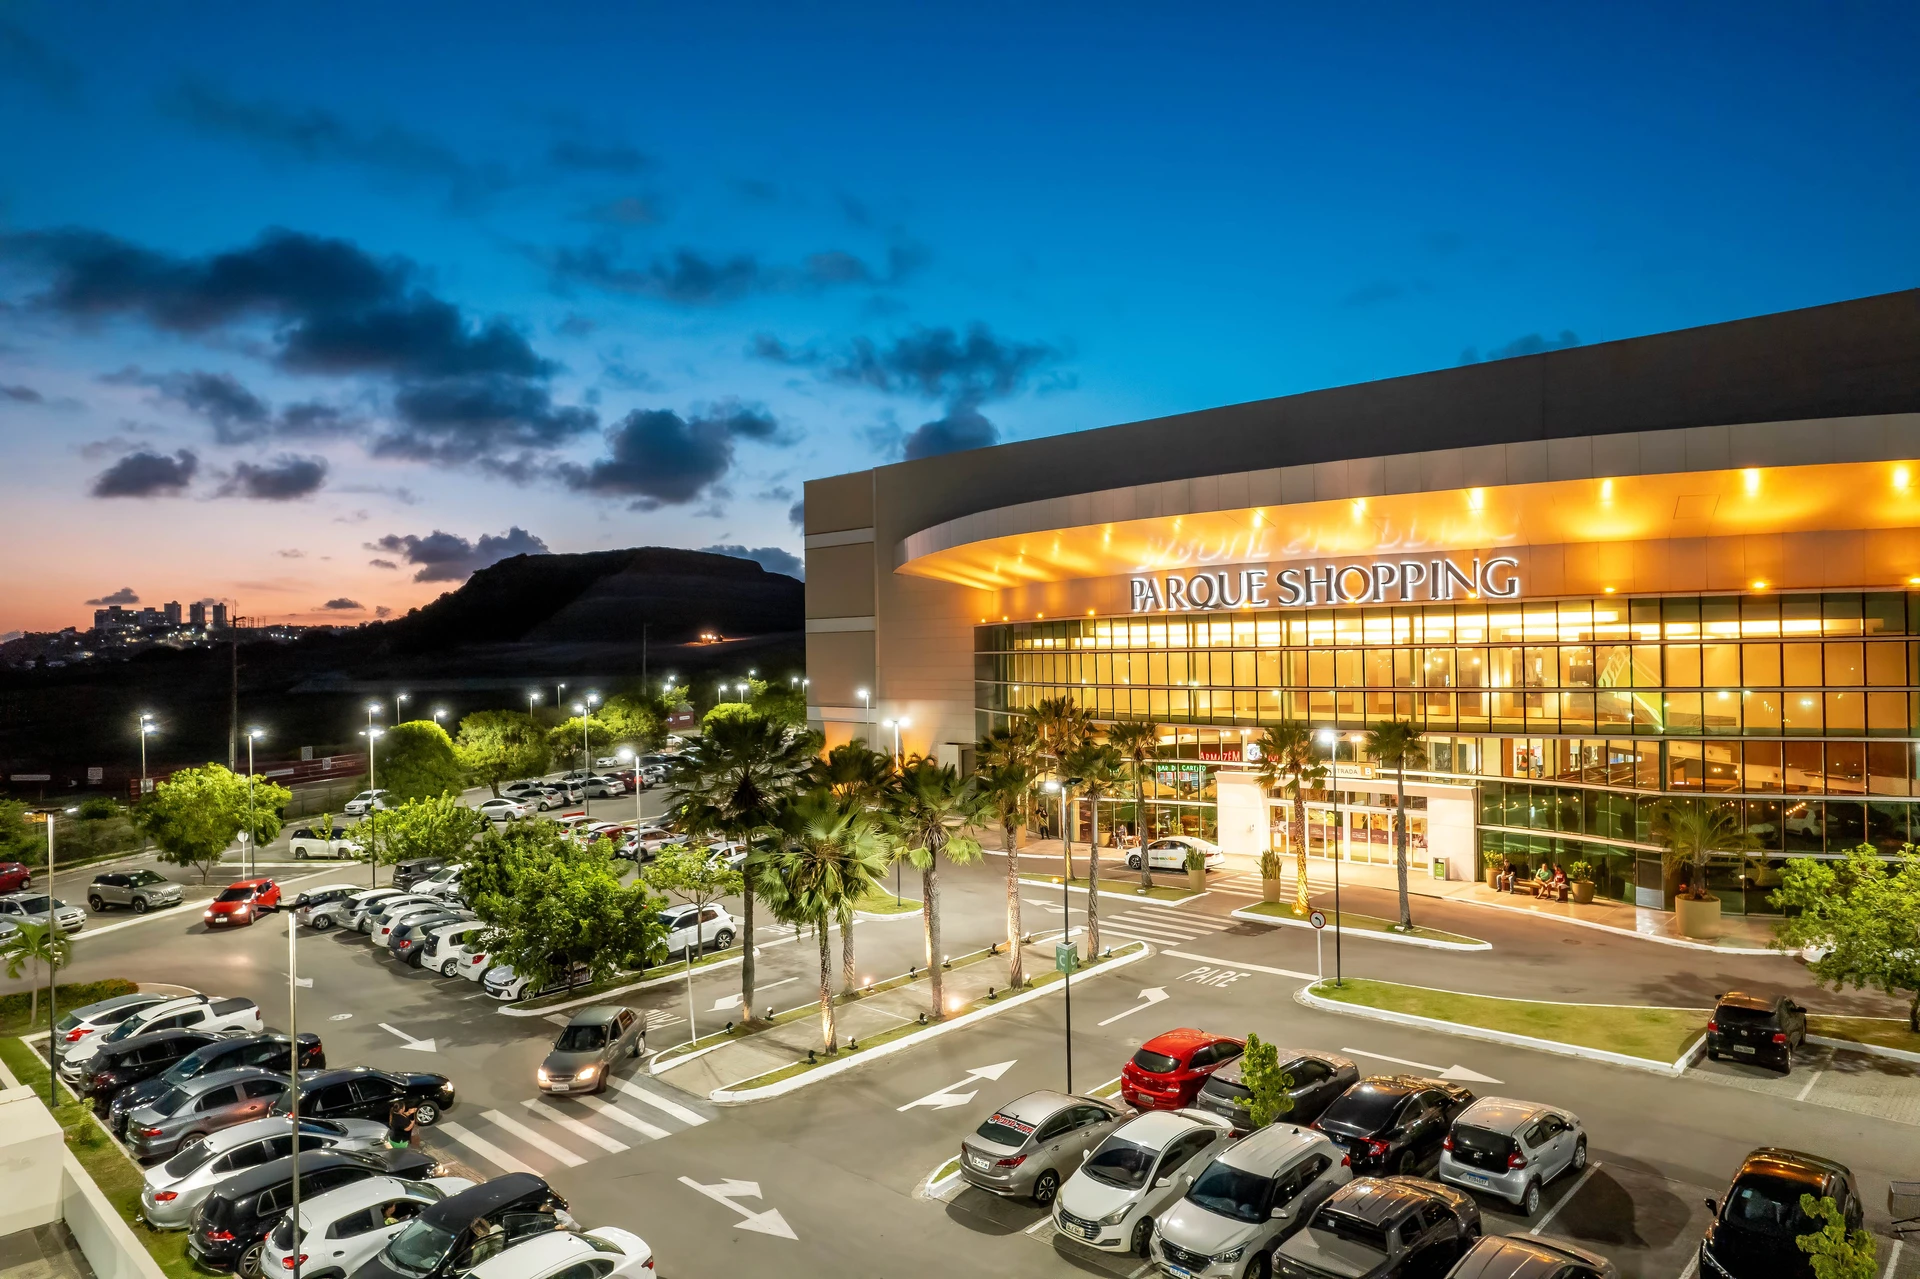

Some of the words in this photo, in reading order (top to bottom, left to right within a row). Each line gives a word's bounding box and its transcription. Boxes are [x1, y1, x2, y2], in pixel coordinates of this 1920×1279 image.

[1130, 570, 1269, 611] PARQUE
[1277, 558, 1520, 606] SHOPPING
[1059, 955, 1066, 967] C
[1071, 953, 1076, 966] C
[1176, 966, 1252, 988] PARE
